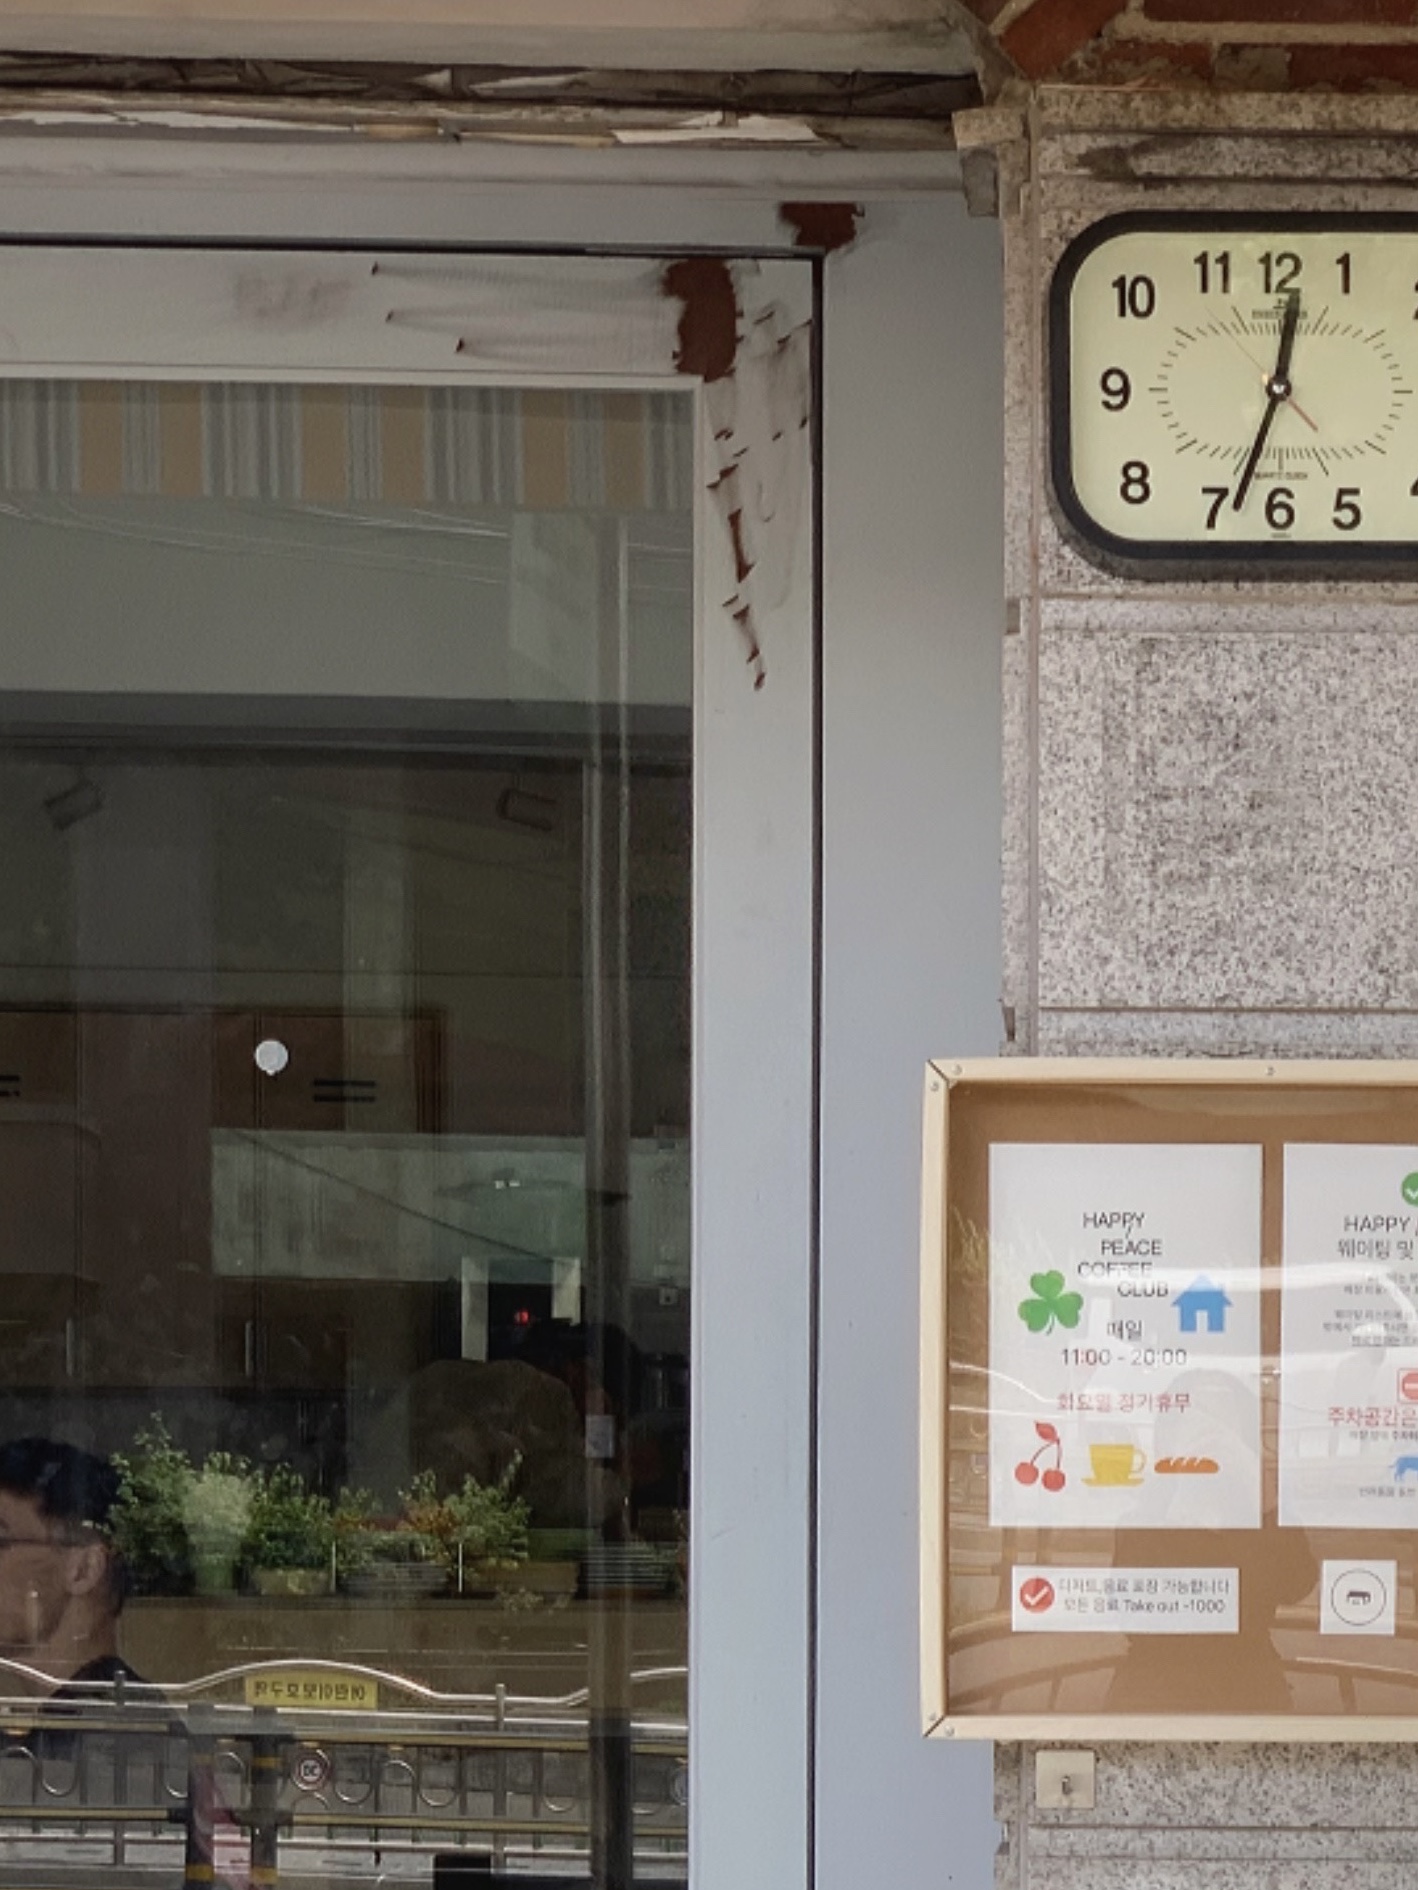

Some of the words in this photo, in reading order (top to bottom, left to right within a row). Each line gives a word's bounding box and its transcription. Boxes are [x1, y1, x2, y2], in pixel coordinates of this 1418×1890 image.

[1193, 250, 1231, 295] 11
[1257, 251, 1303, 295] 12
[1335, 252, 1351, 295] 1
[1112, 274, 1156, 319] 10
[1100, 367, 1132, 412] 9
[1120, 460, 1151, 505] 8
[1201, 487, 1230, 530] 7
[1264, 487, 1296, 531] 6
[1332, 487, 1362, 531] 5
[1083, 1211, 1145, 1229] HAPPY
[1343, 1215, 1411, 1233] HAPPY
[1101, 1239, 1163, 1256] PEACE
[1338, 1238, 1392, 1261] 웨이팅
[1396, 1239, 1415, 1261] 및
[1077, 1261, 1153, 1278] COFFEE
[1117, 1281, 1169, 1298] CLUB
[1107, 1319, 1142, 1341] 매일
[1061, 1348, 1111, 1367] 11:00
[1131, 1348, 1188, 1367] 20:00
[1057, 1391, 1112, 1414] 화요일
[1119, 1391, 1192, 1414] 정기휴무
[1328, 1407, 1418, 1429] 주차공간은
[1123, 1598, 1155, 1613] Take
[1157, 1599, 1180, 1613] out
